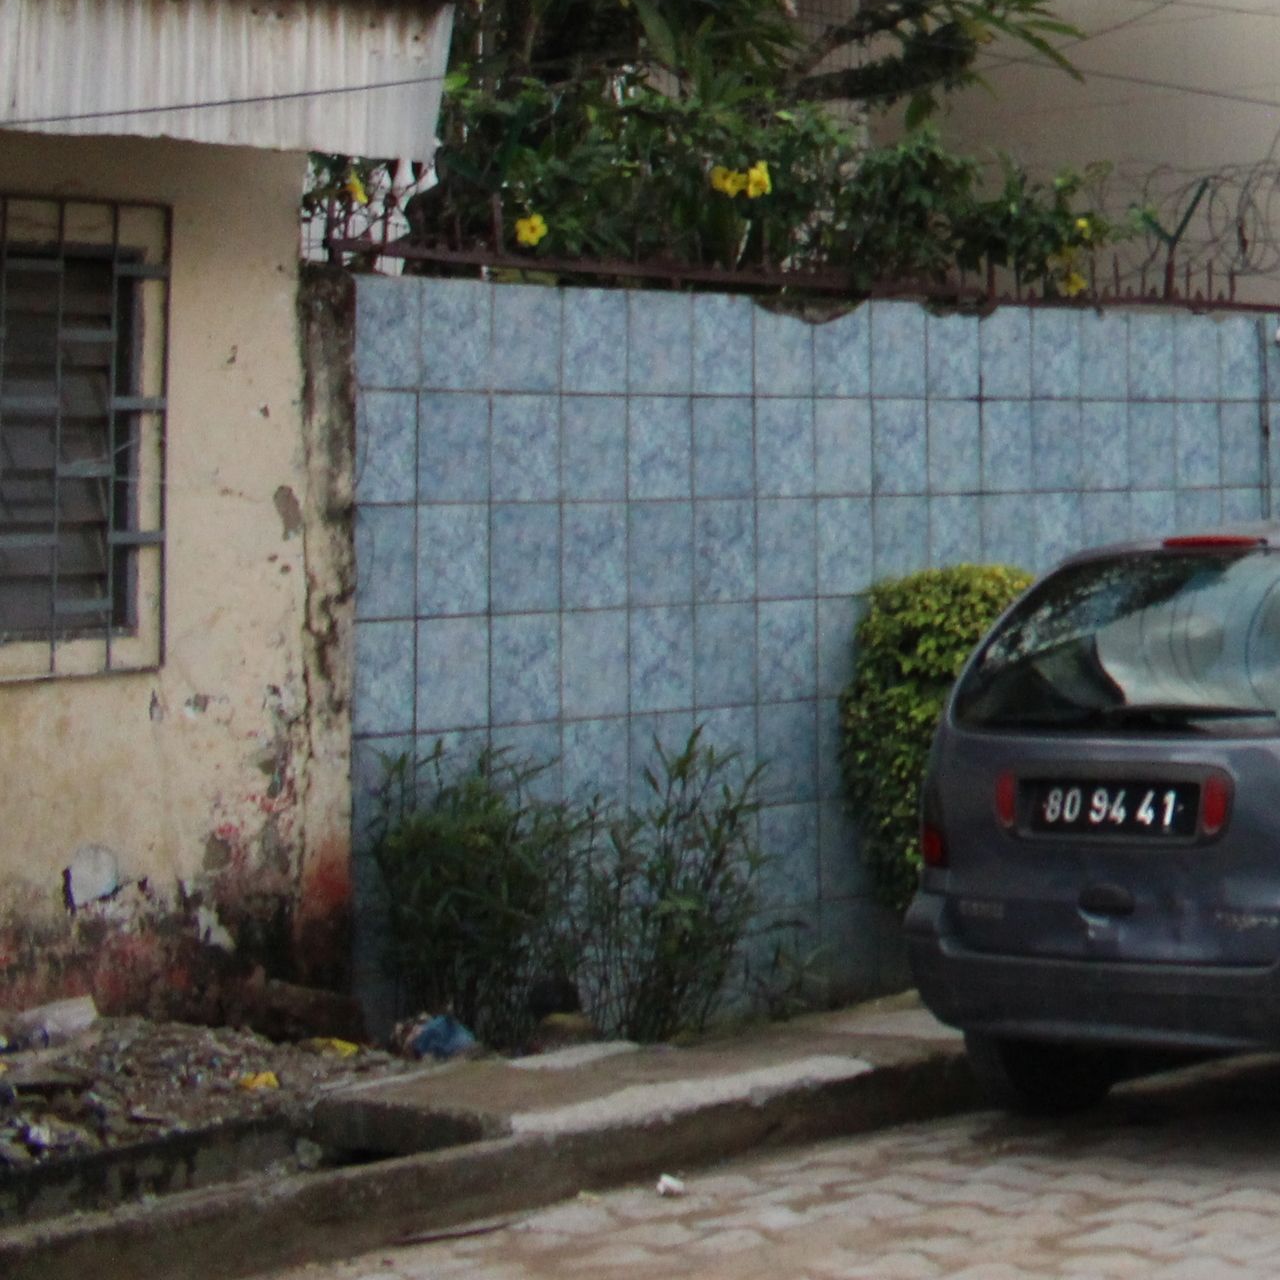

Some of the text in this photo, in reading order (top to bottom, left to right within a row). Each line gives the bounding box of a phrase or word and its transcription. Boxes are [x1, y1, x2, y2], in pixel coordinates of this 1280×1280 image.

[1045, 787, 1177, 826] 80 94 41
